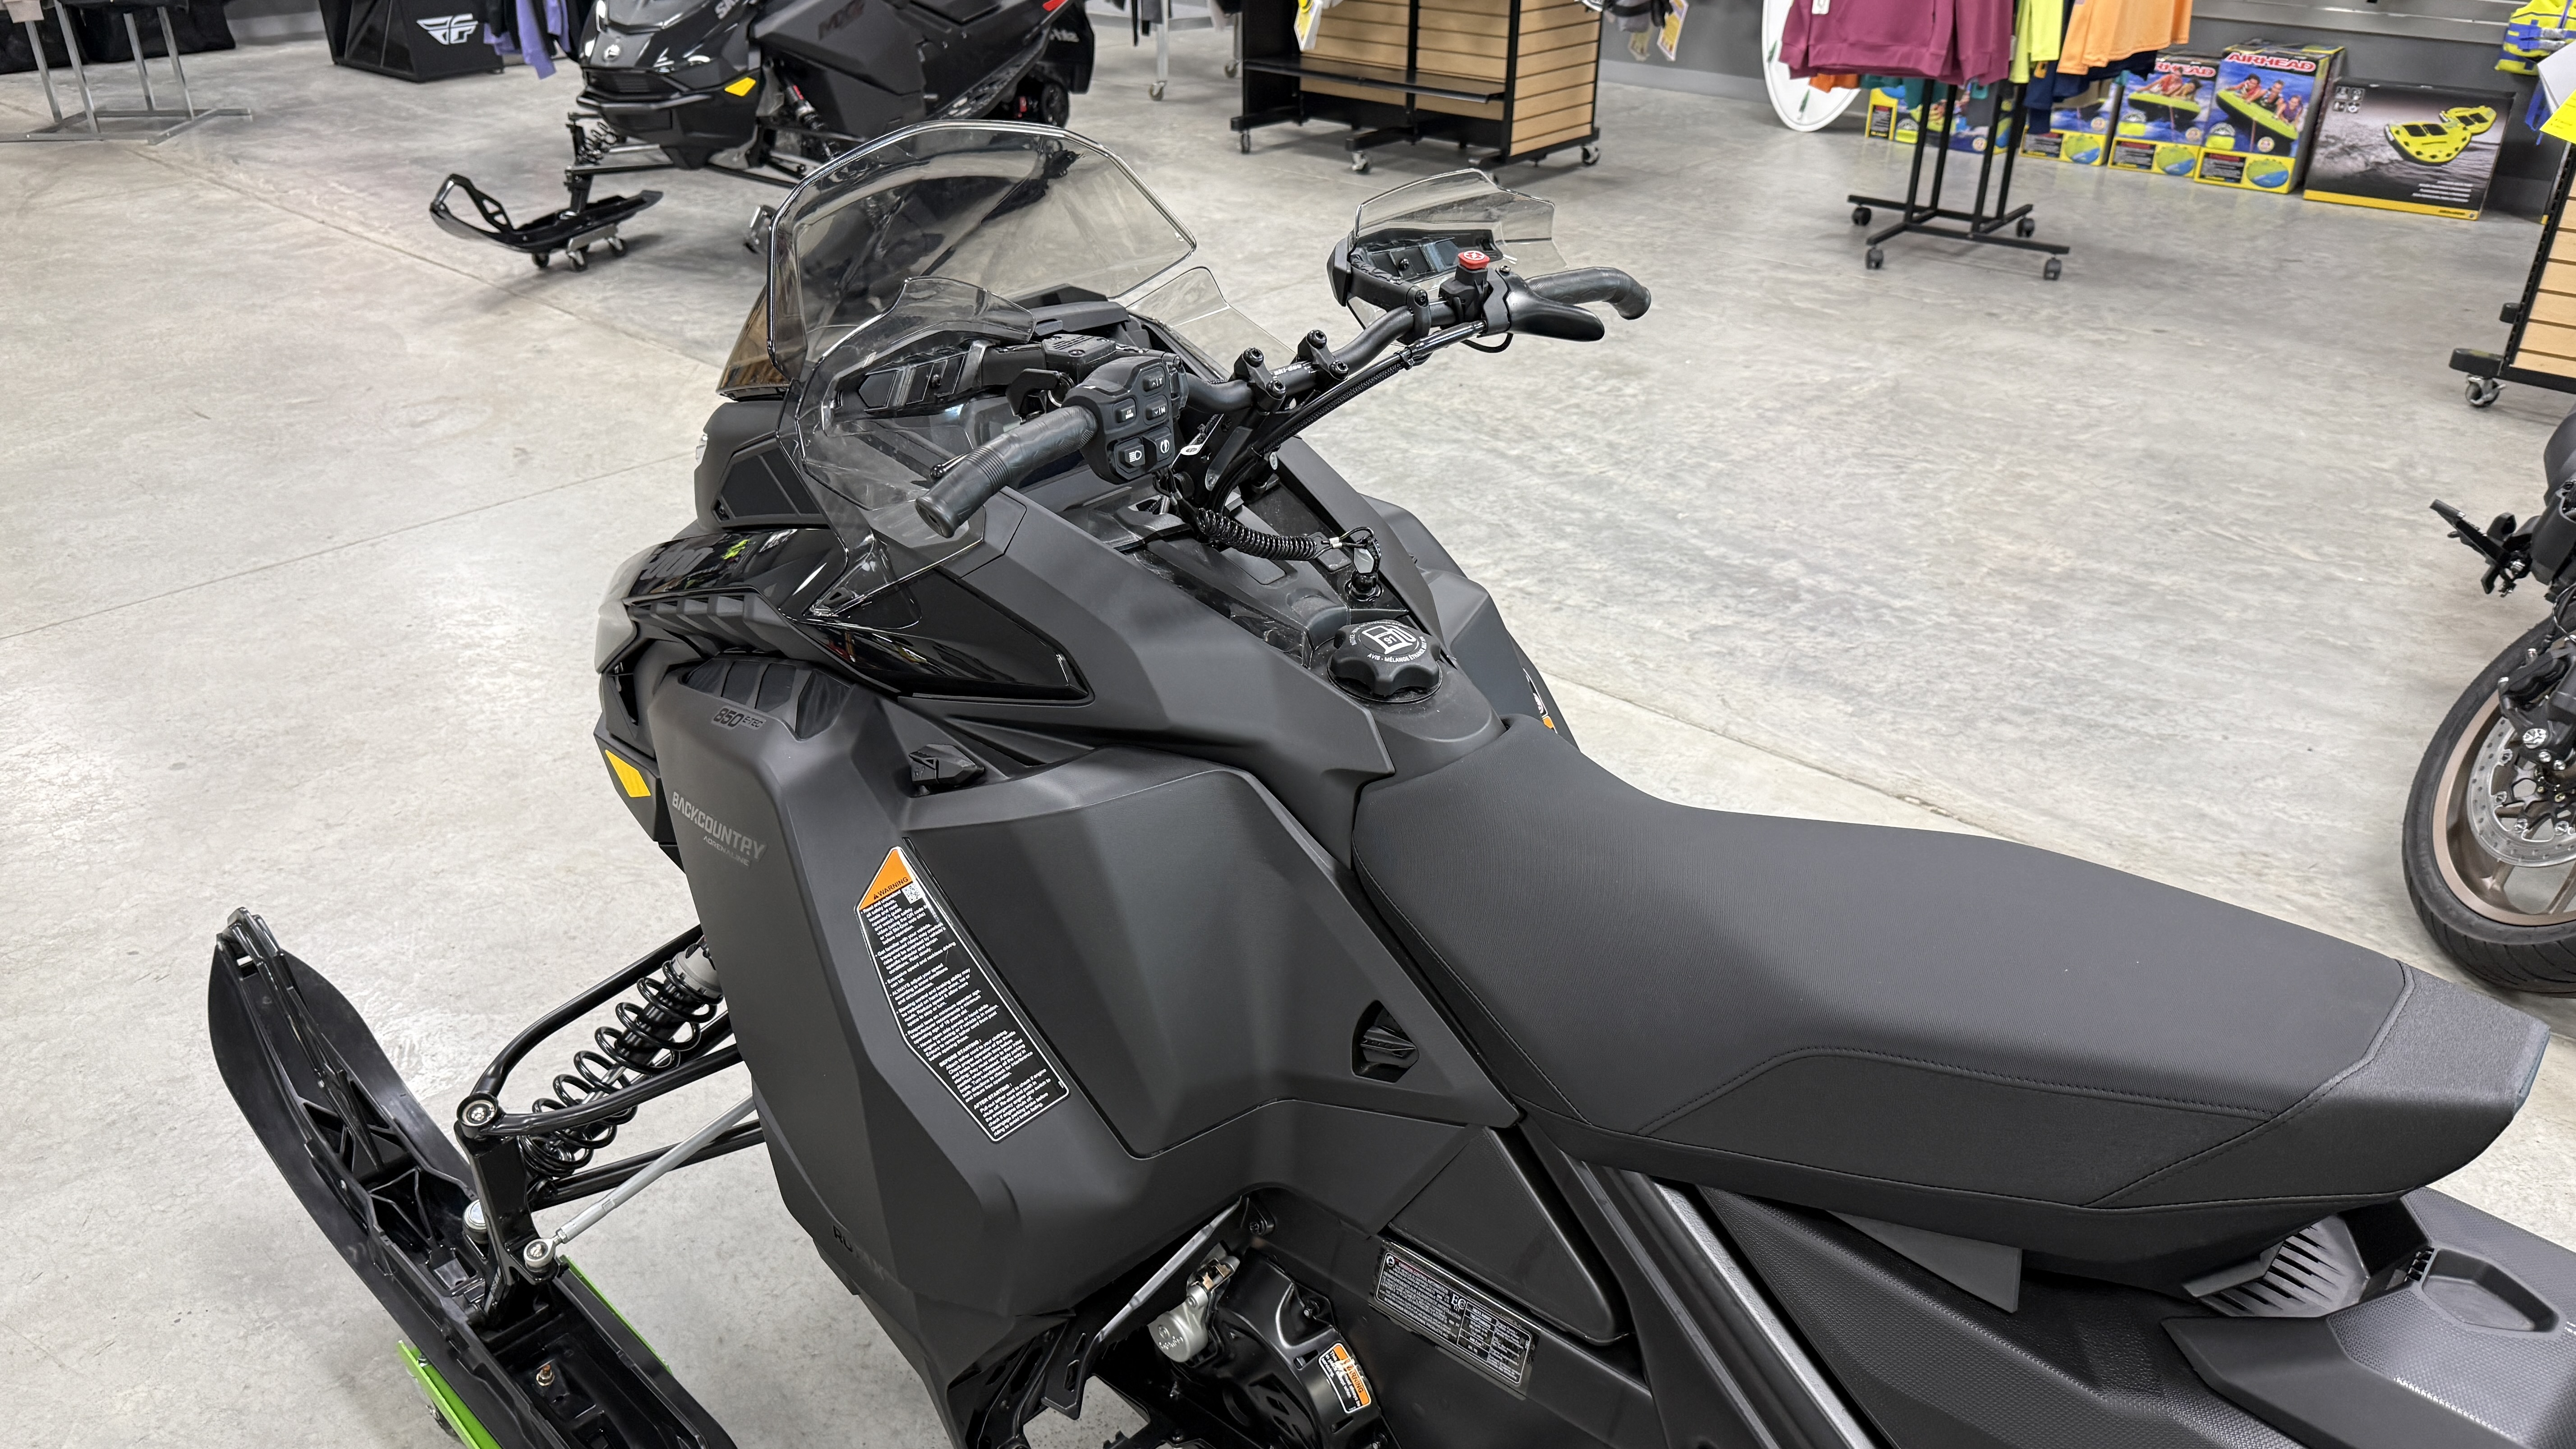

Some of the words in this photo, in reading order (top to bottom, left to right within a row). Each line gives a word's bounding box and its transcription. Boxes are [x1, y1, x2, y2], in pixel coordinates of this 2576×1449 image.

[2155, 61, 2217, 78] RHEAD
[2225, 52, 2316, 73] AIRHEAD
[1384, 635, 1397, 644] 91
[713, 708, 745, 727] 850
[742, 716, 763, 727] E-TEC
[672, 791, 765, 859] BACKCOUNTRY
[704, 836, 751, 866] ADRENALINE
[877, 876, 909, 897] WARNING
[1343, 1359, 1365, 1393] WARNING
